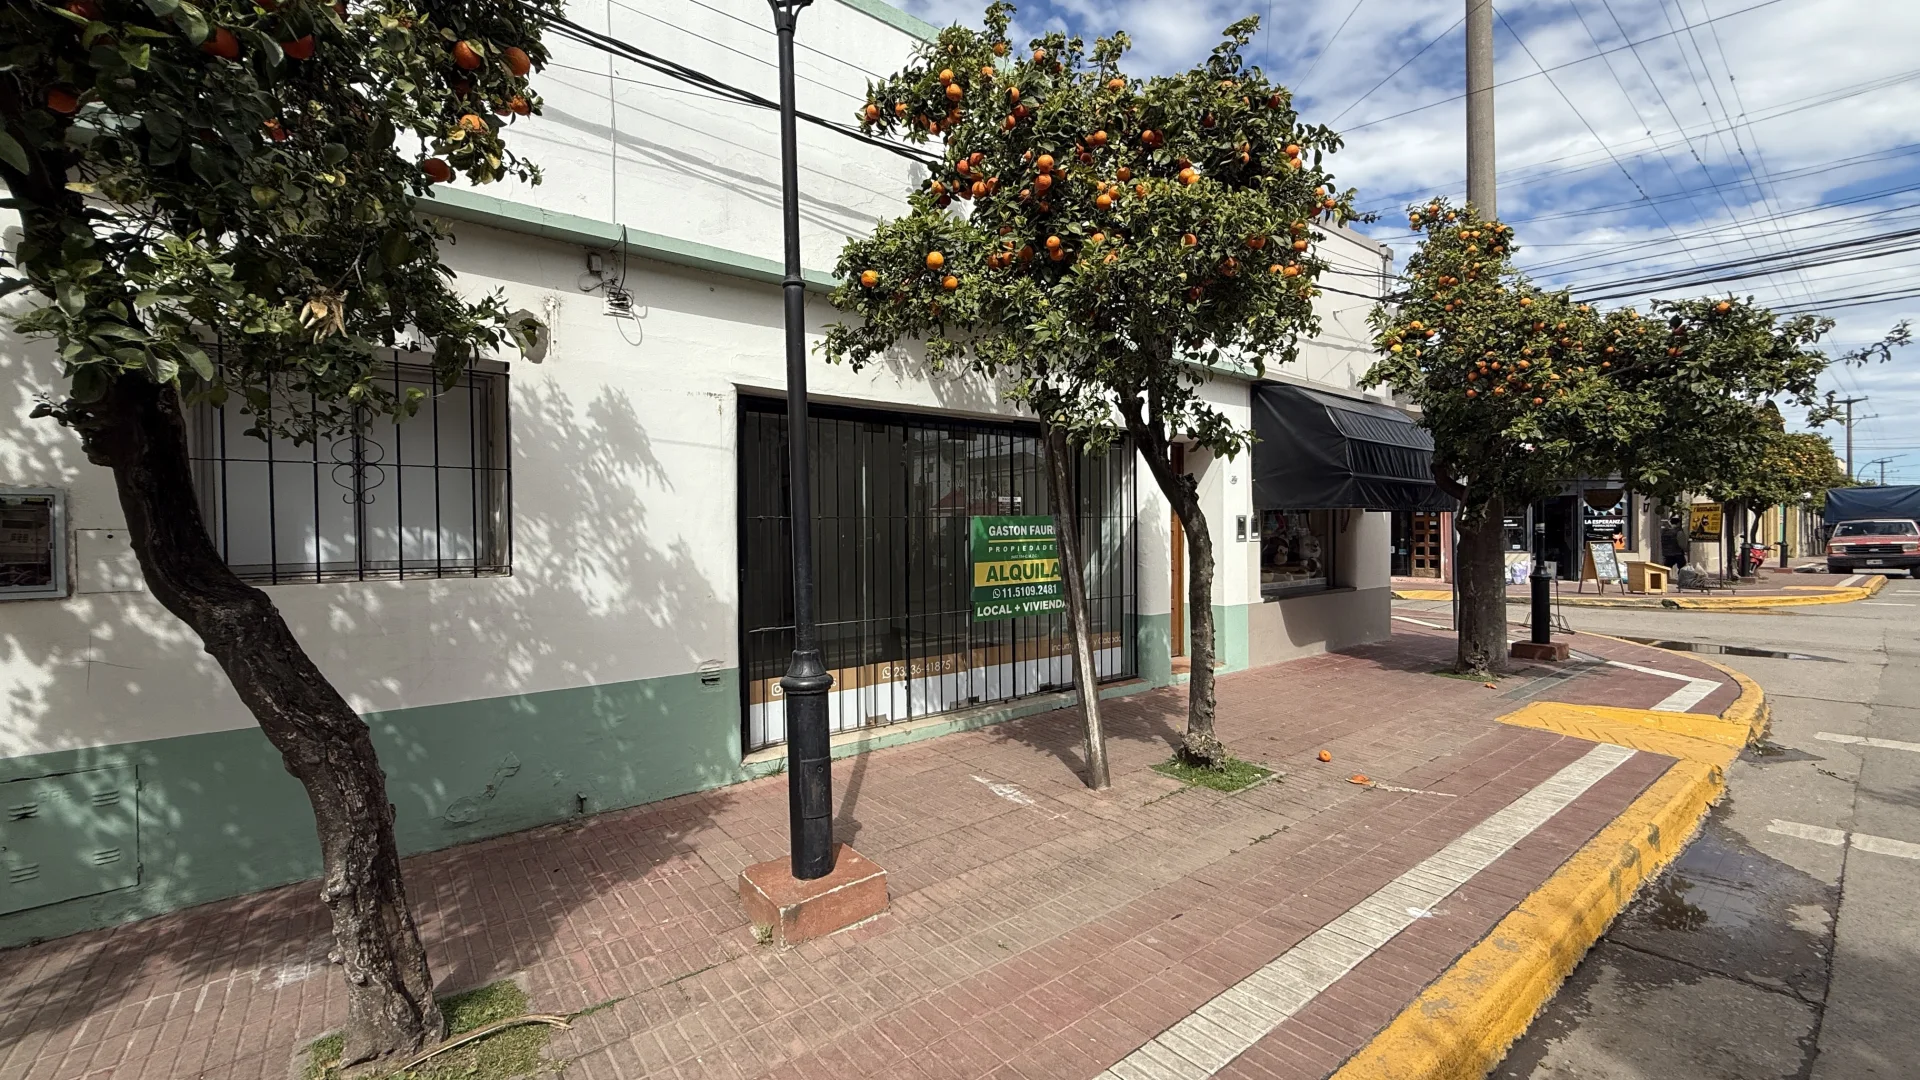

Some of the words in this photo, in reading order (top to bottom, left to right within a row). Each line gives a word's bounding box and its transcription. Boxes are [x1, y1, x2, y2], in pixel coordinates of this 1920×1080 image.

[988, 525, 1028, 536] GASTON
[1029, 525, 1056, 536] FAUR
[986, 562, 1060, 582] ALQUILA
[1002, 584, 1057, 598] 11.5109.2481
[977, 604, 1012, 617] LOCAL
